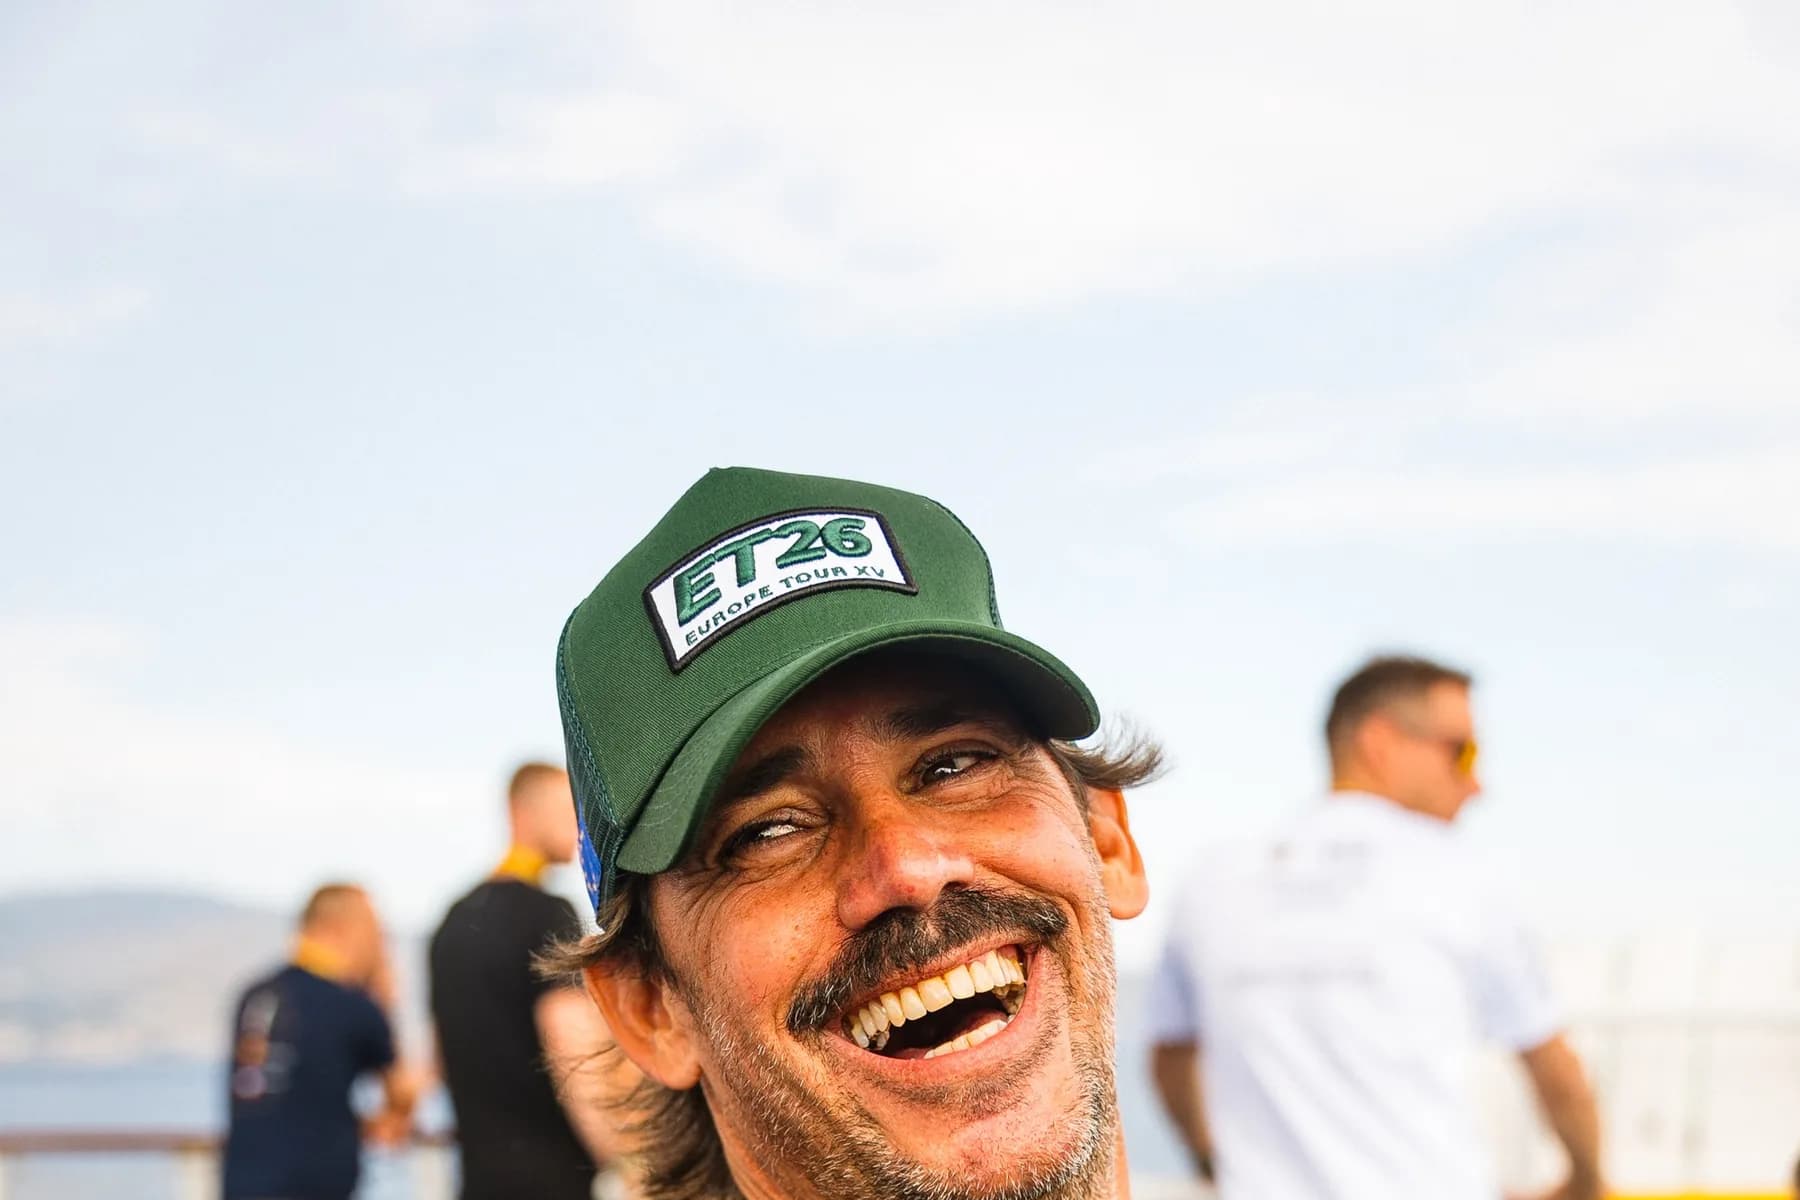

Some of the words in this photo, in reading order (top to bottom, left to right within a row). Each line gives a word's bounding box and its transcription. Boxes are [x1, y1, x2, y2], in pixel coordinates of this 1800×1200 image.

[672, 517, 873, 628] ET26
[685, 584, 774, 647] EUROPE
[778, 566, 849, 589] TOUR
[853, 565, 885, 578] XV
